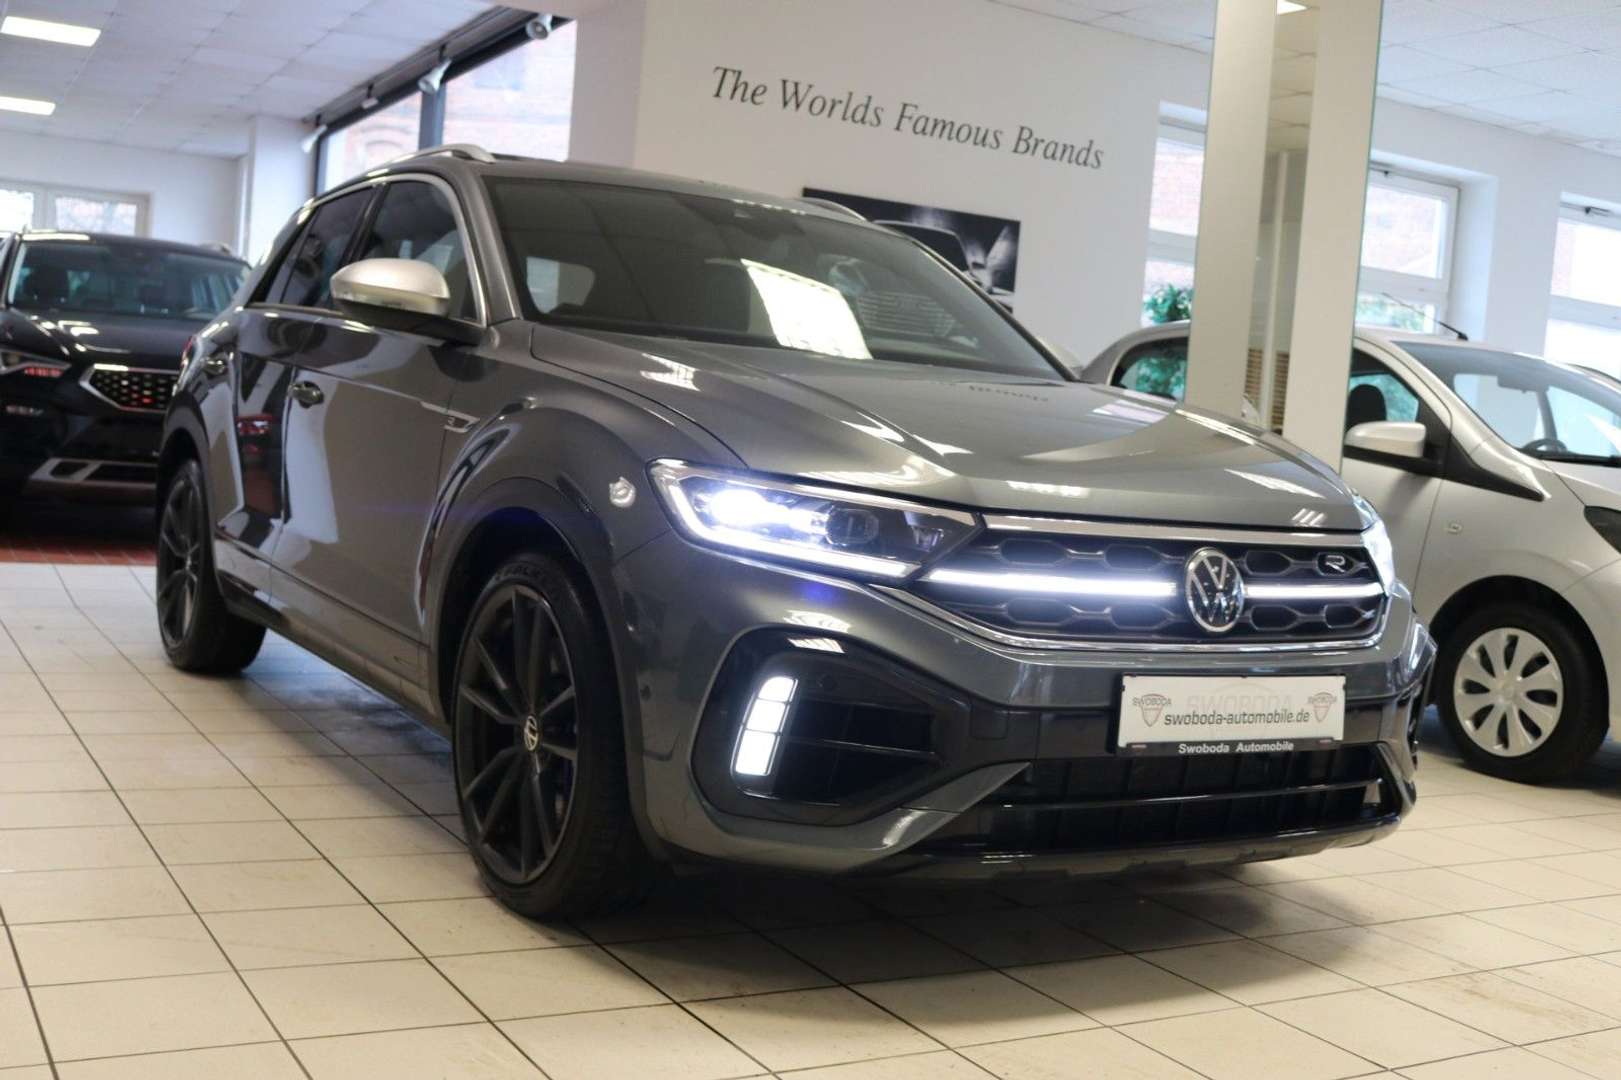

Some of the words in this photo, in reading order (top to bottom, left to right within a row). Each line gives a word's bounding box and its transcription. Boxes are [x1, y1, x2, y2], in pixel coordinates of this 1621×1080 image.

[712, 66, 768, 105] The
[780, 79, 884, 128] Worlds
[894, 102, 1002, 150] Famous
[1012, 125, 1104, 169] Brands
[1164, 709, 1310, 726] swoboda-automobile.de
[1178, 743, 1230, 754] Swoboda
[1235, 741, 1294, 753] Automobile
